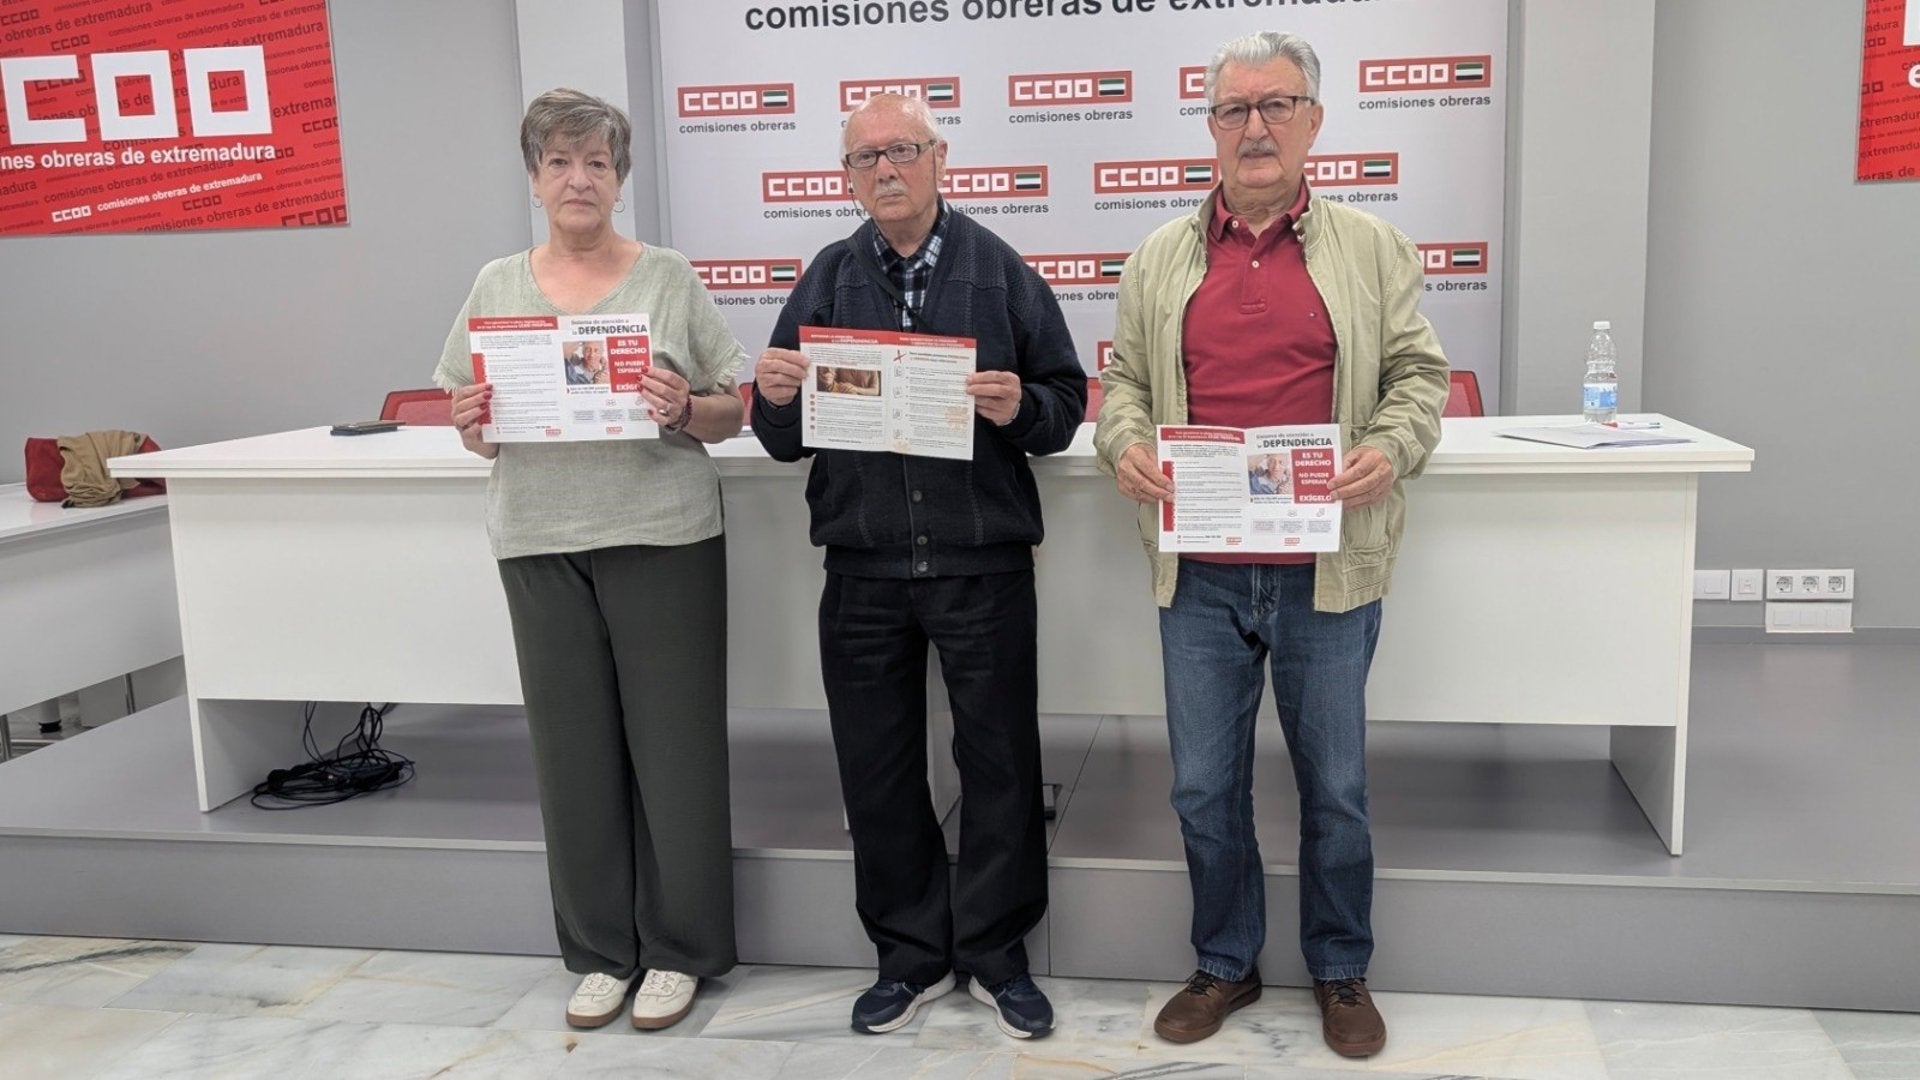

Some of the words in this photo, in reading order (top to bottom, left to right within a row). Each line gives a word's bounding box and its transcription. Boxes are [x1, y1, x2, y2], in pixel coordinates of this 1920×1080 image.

[5, 24, 52, 41] obreras
[55, 19, 71, 31] de
[74, 2, 153, 27] extremadura
[177, 23, 230, 40] comisiones
[232, 15, 268, 28] obreras
[269, 11, 281, 20] de
[284, 2, 326, 16] extremad
[744, 0, 949, 30] comisiones
[50, 33, 90, 52] CCOO
[242, 22, 324, 46] extremadura
[1365, 63, 1449, 86] CCOO
[0, 45, 272, 145] COO
[1014, 79, 1093, 100] CCOO
[272, 96, 336, 118] extrema
[683, 91, 757, 111] CCOO
[1359, 97, 1435, 109] comisiones
[1439, 95, 1490, 107] obreras
[936, 116, 961, 126] eras
[1008, 111, 1080, 123] comisiones
[1085, 109, 1133, 121] obreras
[1860, 110, 1920, 129] xtremadur
[679, 122, 746, 133] comisiones
[750, 121, 796, 132] obreras
[41, 150, 116, 168] obreras
[121, 147, 145, 165] de
[150, 142, 276, 164] extremadura
[1860, 141, 1920, 158] extremadu
[1100, 167, 1178, 187] CCOO
[1304, 160, 1357, 180] COO
[1899, 166, 1916, 178] de
[44, 184, 104, 204] comisiones
[107, 177, 147, 192] obreras
[150, 171, 163, 182] de
[166, 160, 234, 179] extremadura
[768, 176, 842, 197] CCOO
[52, 205, 91, 223] CCOO
[97, 195, 150, 212] comisiones
[152, 187, 188, 201] obreras
[189, 183, 202, 194] de
[203, 172, 263, 192] extremadura
[182, 195, 222, 211] CCOO
[206, 207, 252, 222] obreras
[255, 202, 269, 213] de
[272, 188, 345, 210] extremadura
[1095, 198, 1166, 210] comisiones
[1170, 197, 1203, 208] obre
[1348, 191, 1398, 203] obreras
[764, 207, 832, 219] comisiones
[836, 206, 868, 217] obrer
[955, 204, 998, 215] isiones
[1002, 203, 1049, 214] obreras
[1026, 261, 1096, 279] COO
[1436, 280, 1488, 292] obreras
[714, 295, 756, 306] isiones
[760, 294, 789, 305] obre
[1087, 290, 1119, 301] obre
[578, 324, 648, 336] DEPENDENCIA
[610, 347, 647, 355] DERECHO
[1263, 438, 1333, 449] DEPENDENCIA
[1295, 459, 1332, 467] DERECHO
[1312, 451, 1323, 459] TU
